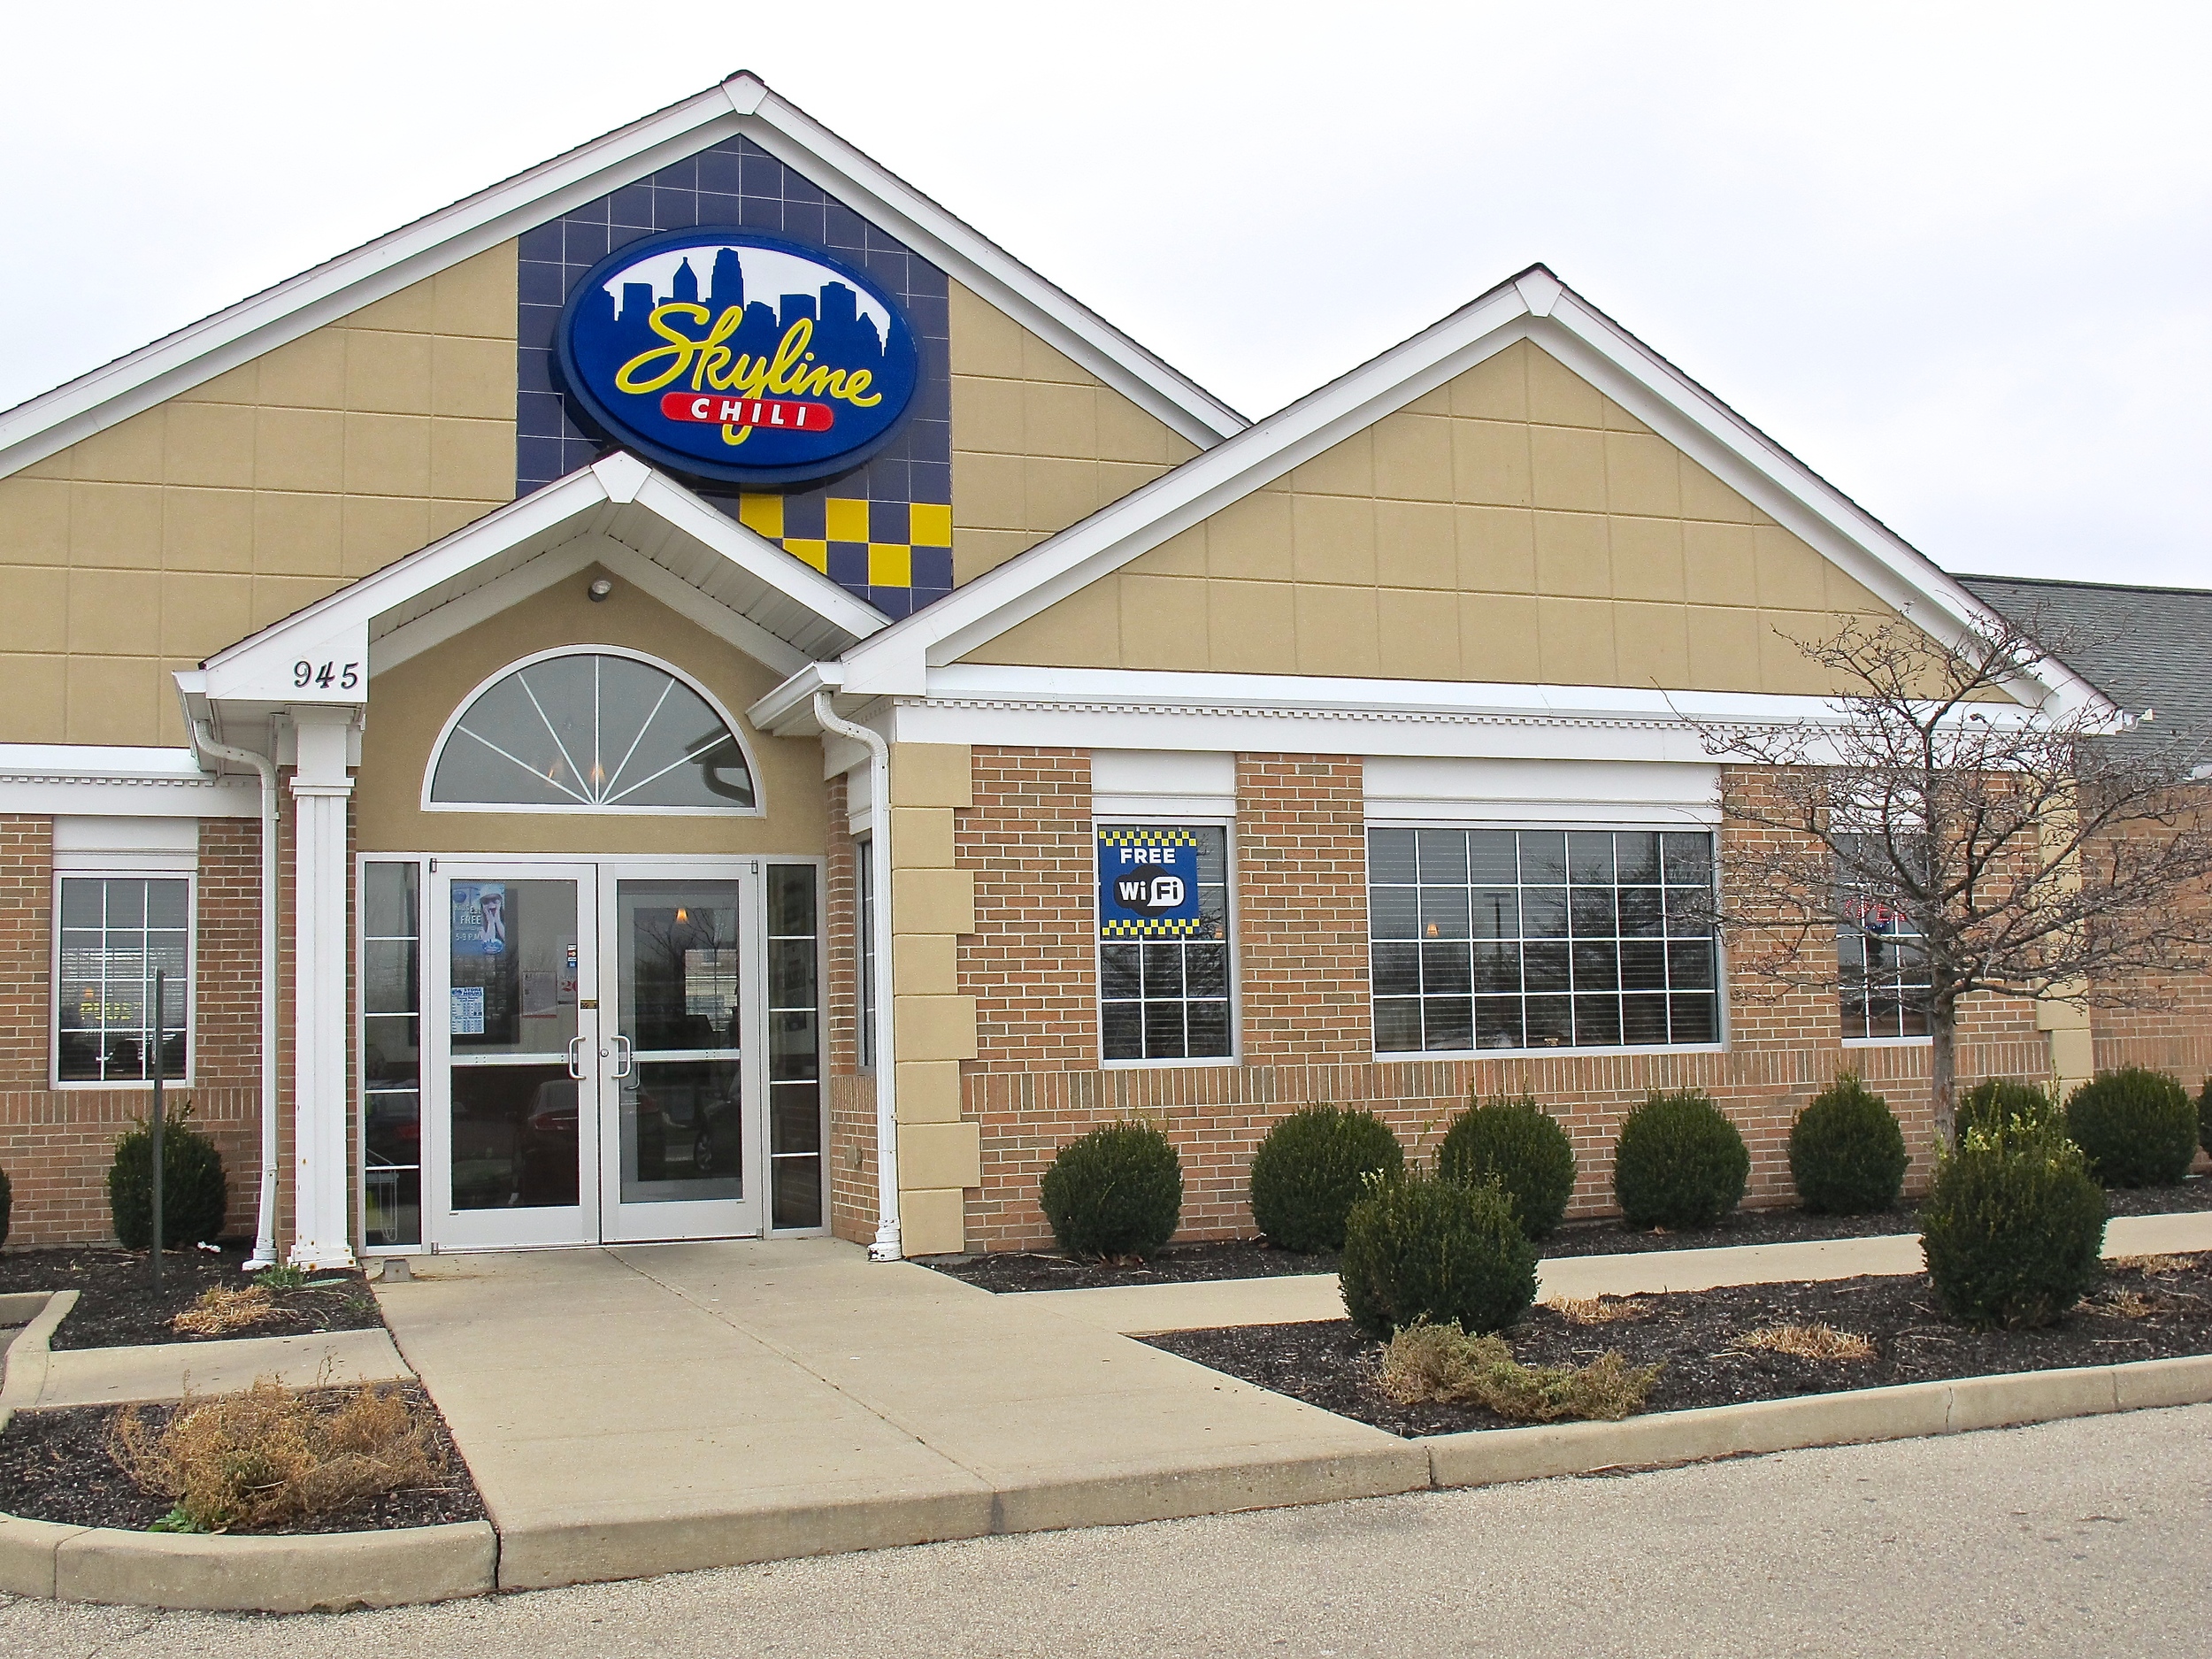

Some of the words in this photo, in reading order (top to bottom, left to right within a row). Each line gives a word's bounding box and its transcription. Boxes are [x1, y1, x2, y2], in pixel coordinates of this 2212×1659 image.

[615, 302, 882, 446] Skyline
[690, 397, 807, 426] CHILI
[294, 660, 359, 689] 945
[1120, 848, 1176, 864] FREE
[460, 915, 482, 925] FREE
